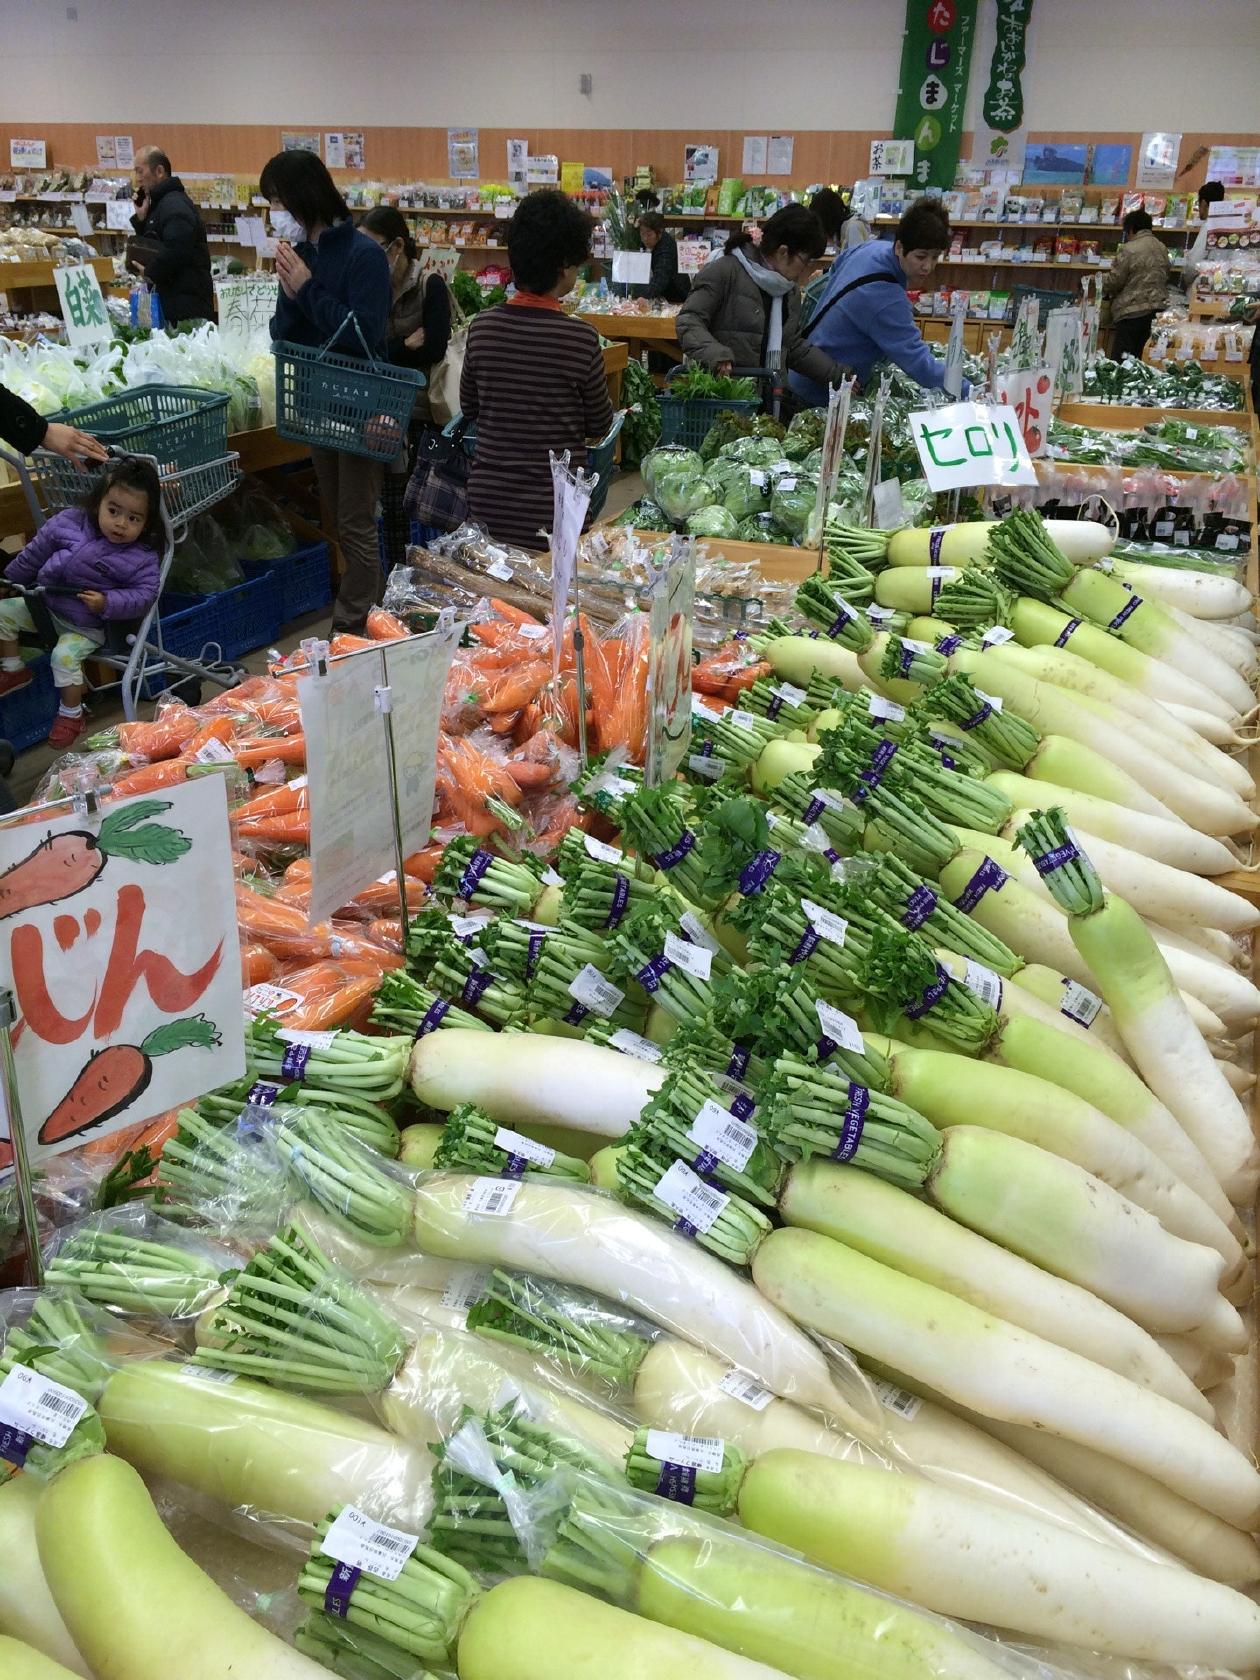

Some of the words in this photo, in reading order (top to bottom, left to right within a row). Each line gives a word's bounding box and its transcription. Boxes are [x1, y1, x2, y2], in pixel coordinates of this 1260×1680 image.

[872, 143, 884, 171] お茶
[65, 270, 106, 328] 白菜
[920, 422, 1020, 473] セロリ
[10, 884, 224, 1051] じん
[348, 1511, 367, 1528] ¥100
